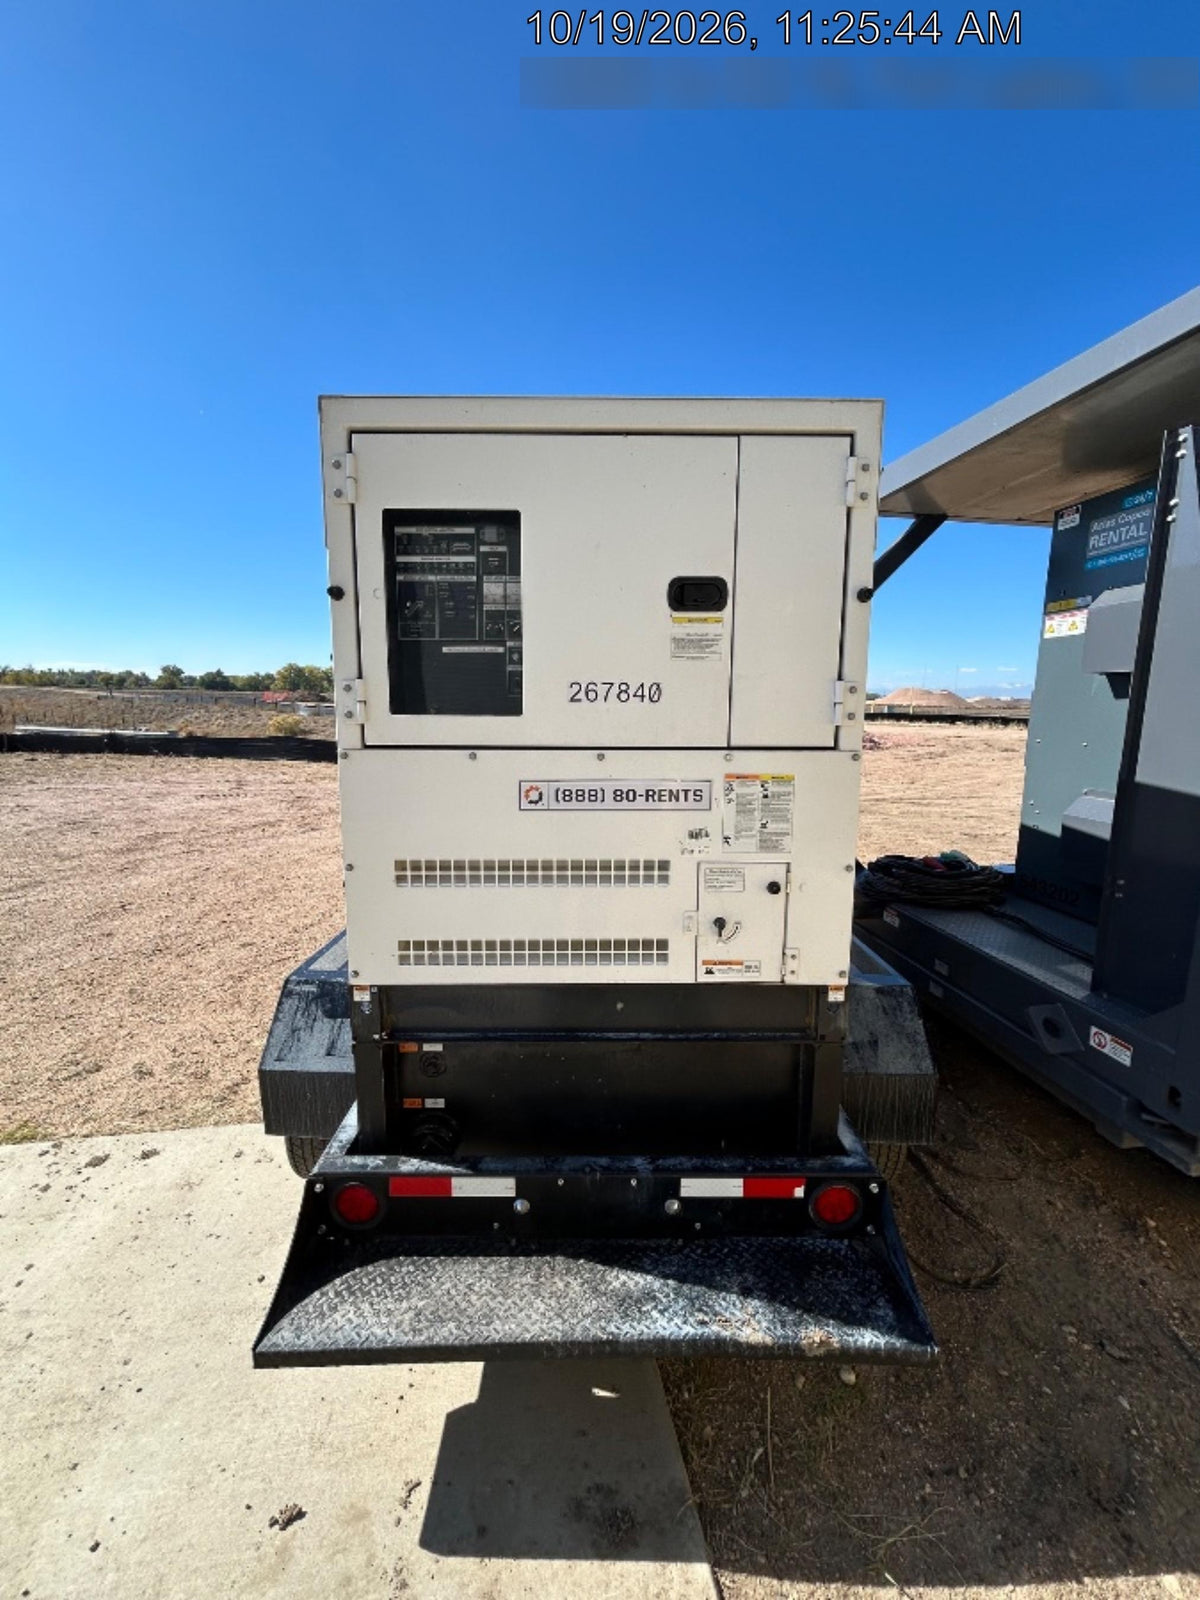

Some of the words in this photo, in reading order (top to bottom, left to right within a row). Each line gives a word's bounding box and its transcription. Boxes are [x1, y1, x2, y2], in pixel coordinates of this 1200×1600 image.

[1089, 522, 1147, 549] RENTAL
[570, 683, 661, 702] 267840
[556, 788, 604, 802] (888)
[613, 789, 702, 802] 80-RENTS
